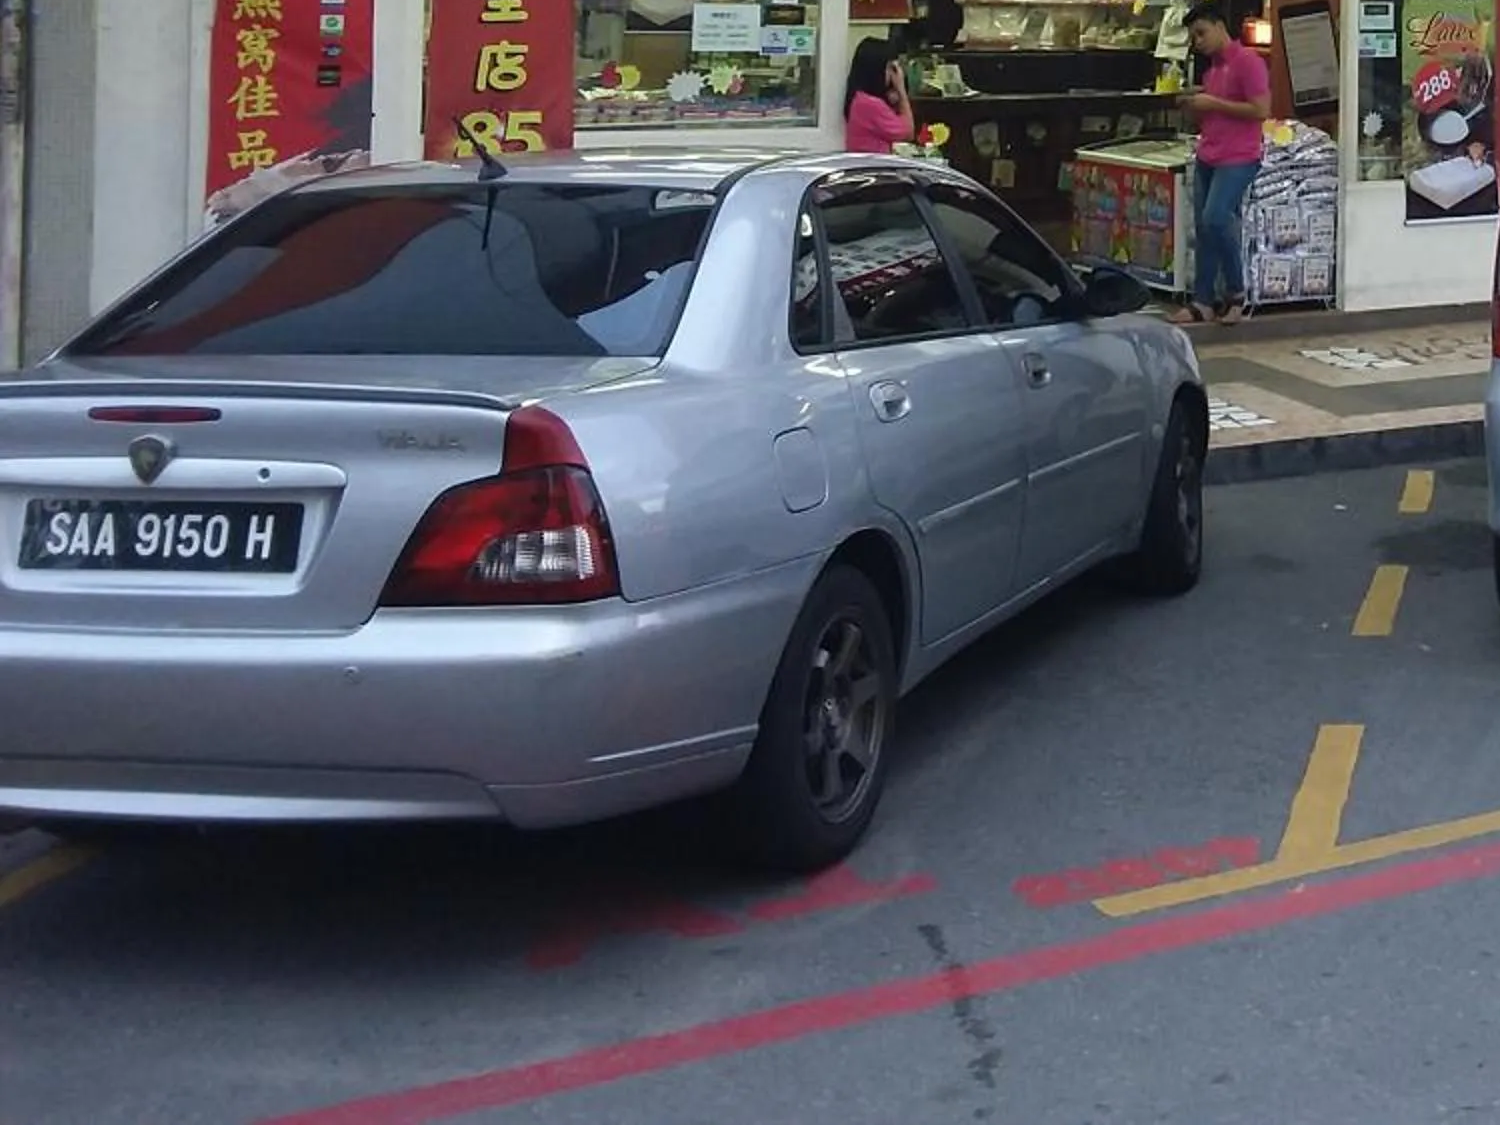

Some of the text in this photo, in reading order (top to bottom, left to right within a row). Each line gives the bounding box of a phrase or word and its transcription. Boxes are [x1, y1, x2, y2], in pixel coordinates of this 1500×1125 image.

[1406, 10, 1475, 55] Latex
[1419, 69, 1451, 103] 288
[46, 512, 275, 560] SAA 9150 H
